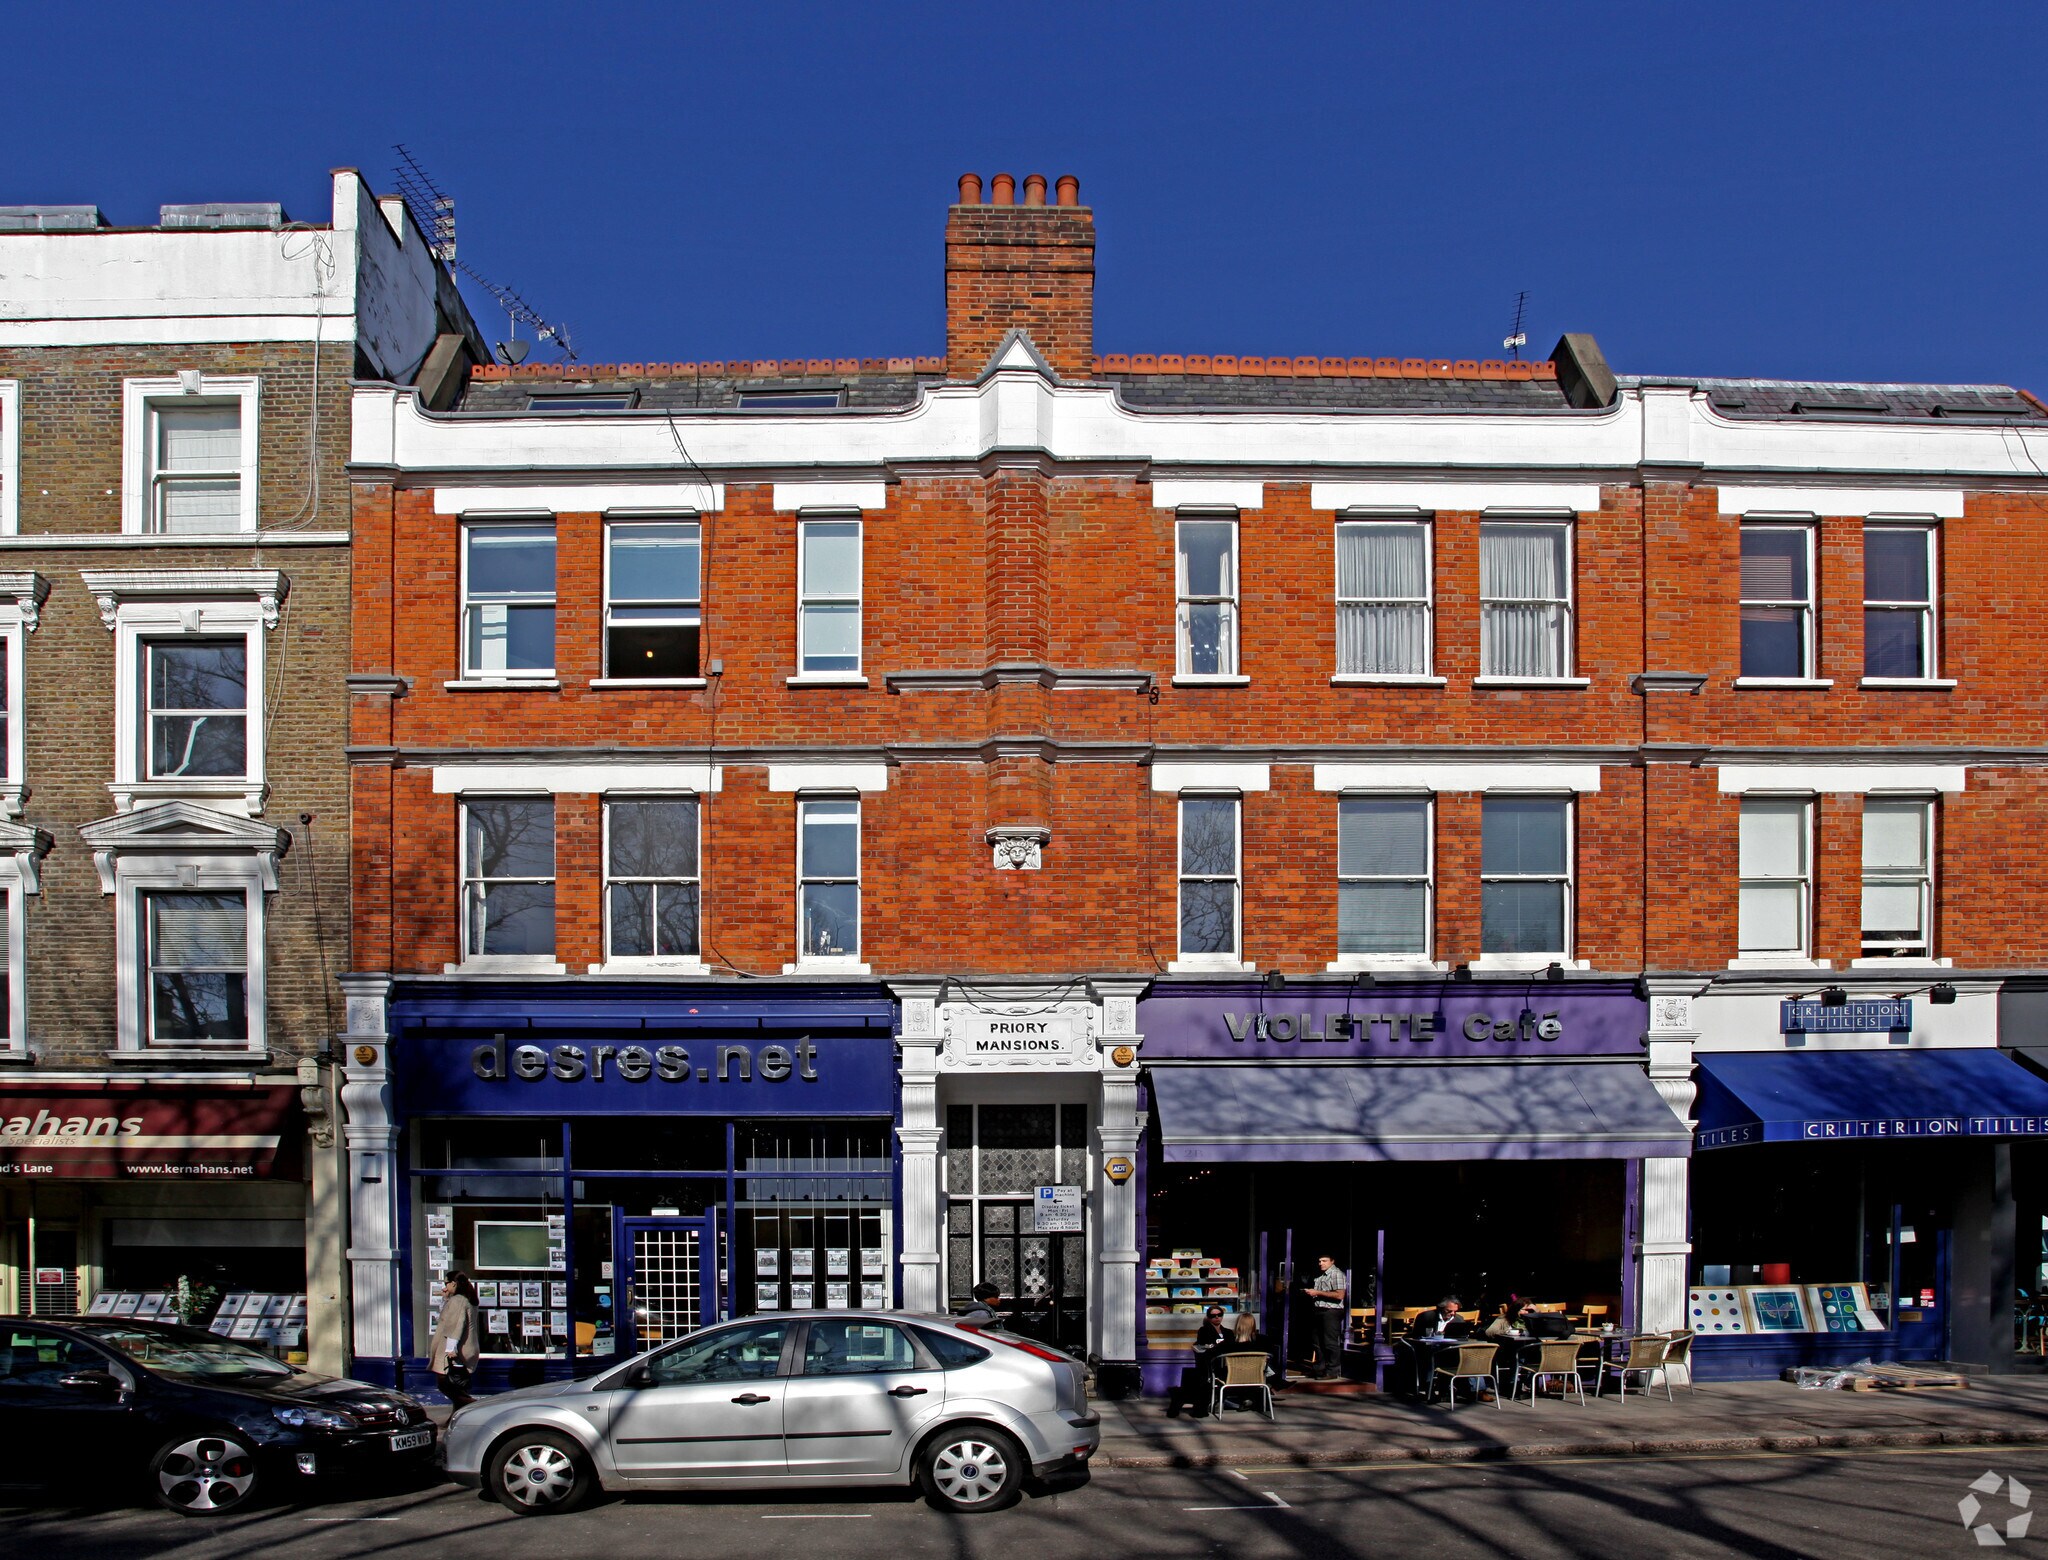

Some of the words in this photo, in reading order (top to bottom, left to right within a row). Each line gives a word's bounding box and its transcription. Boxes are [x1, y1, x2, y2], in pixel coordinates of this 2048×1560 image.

[1792, 1005, 1903, 1016] CRITERION
[990, 1022, 1048, 1034] PRIORY
[1223, 1012, 1435, 1040] VIOLETTE
[1463, 1009, 1563, 1040] Café
[1818, 1017, 1876, 1027] TILES
[470, 1033, 817, 1079] desres.net
[0, 1109, 144, 1137] ahans
[1806, 1118, 1959, 1137] CRITERION
[8, 1136, 77, 1146] Specialists
[1700, 1127, 1749, 1146] TILES
[24, 1163, 54, 1173] Lane
[126, 1163, 254, 1174] www.kernahans.net
[1112, 1164, 1127, 1173] ADT
[395, 1435, 417, 1450] KM59
